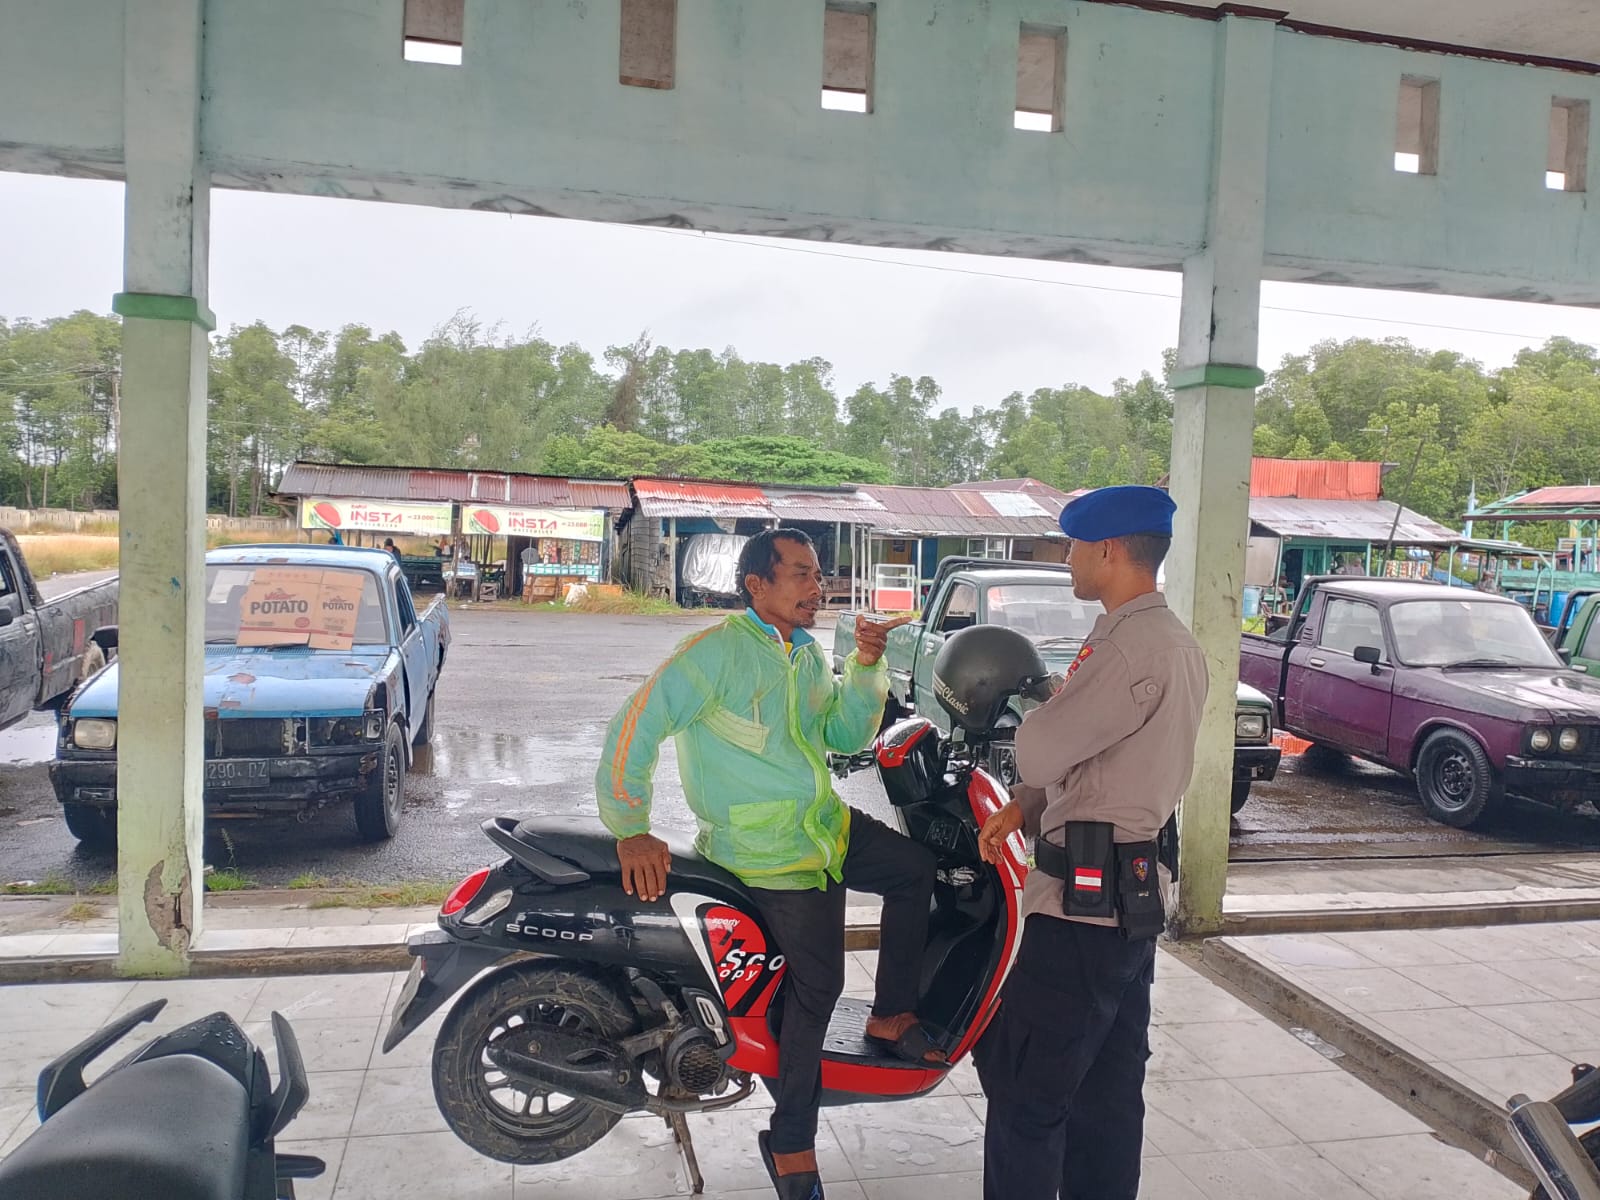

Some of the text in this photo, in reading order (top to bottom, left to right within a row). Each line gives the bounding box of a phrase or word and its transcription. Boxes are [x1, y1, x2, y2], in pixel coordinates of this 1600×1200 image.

[351, 511, 402, 523] INSTA
[509, 517, 557, 530] INSTA
[250, 600, 309, 615] POTATO
[322, 602, 354, 611] POTATO
[942, 686, 969, 715] Classic
[711, 918, 740, 928] sporty
[506, 923, 593, 942] SCOOP
[720, 969, 758, 981] opy
